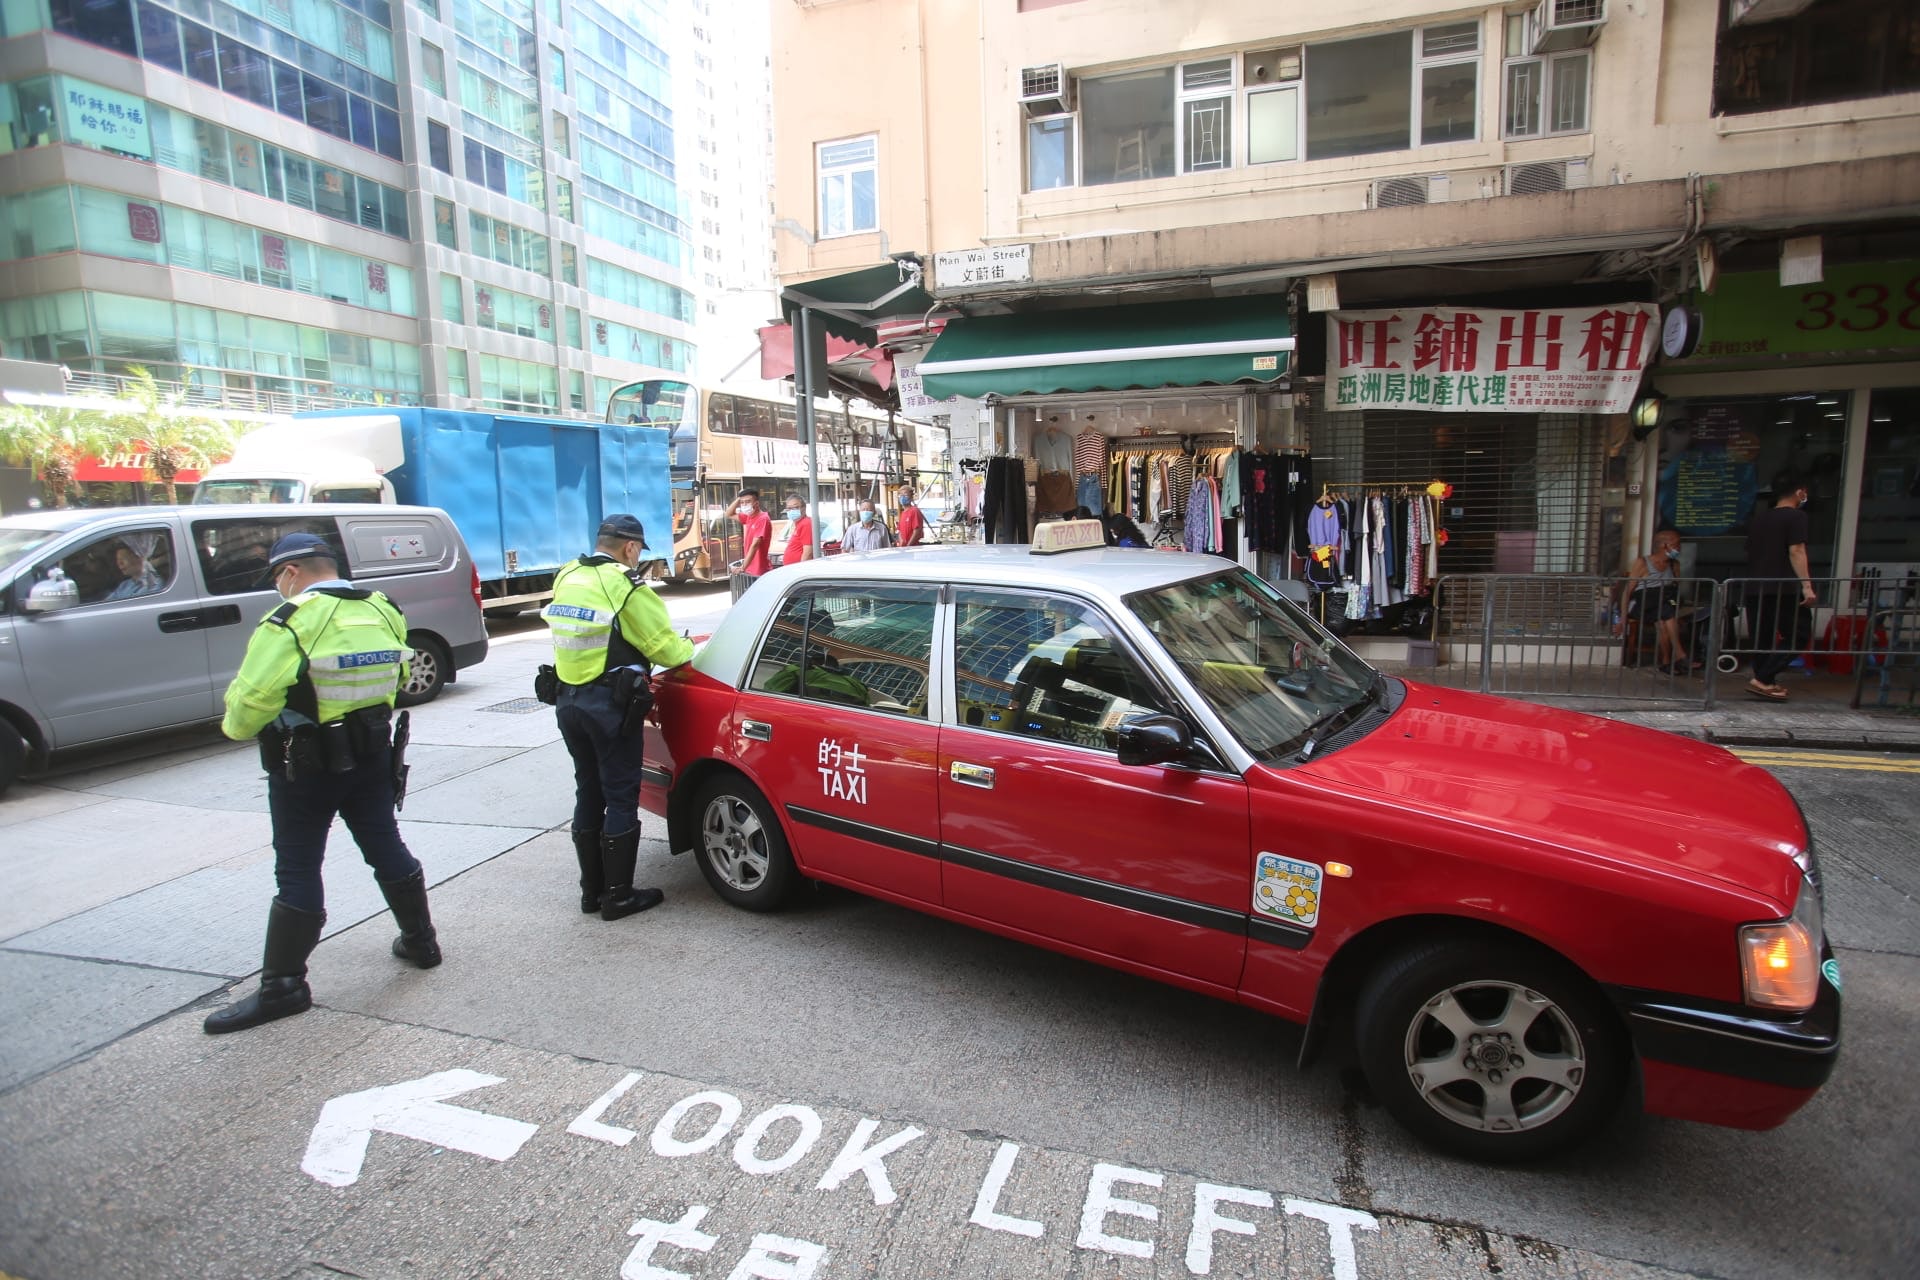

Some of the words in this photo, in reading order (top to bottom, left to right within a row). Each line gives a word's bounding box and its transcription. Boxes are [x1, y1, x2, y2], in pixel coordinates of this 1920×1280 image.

[939, 256, 960, 265] Man
[967, 253, 986, 262] Wai
[992, 248, 1025, 261] Street
[962, 264, 1005, 282] 文蔚街
[1338, 309, 1650, 372] 旺鋪出租
[1336, 372, 1507, 406] 亞洲房地產代理
[1052, 522, 1101, 545] TAXI
[556, 606, 581, 618] POLICE
[357, 652, 395, 665] POLICE
[818, 737, 867, 773] 的士
[817, 766, 867, 805] TAXI
[566, 1072, 925, 1206] LOOK
[969, 1141, 1380, 1280] LEFT
